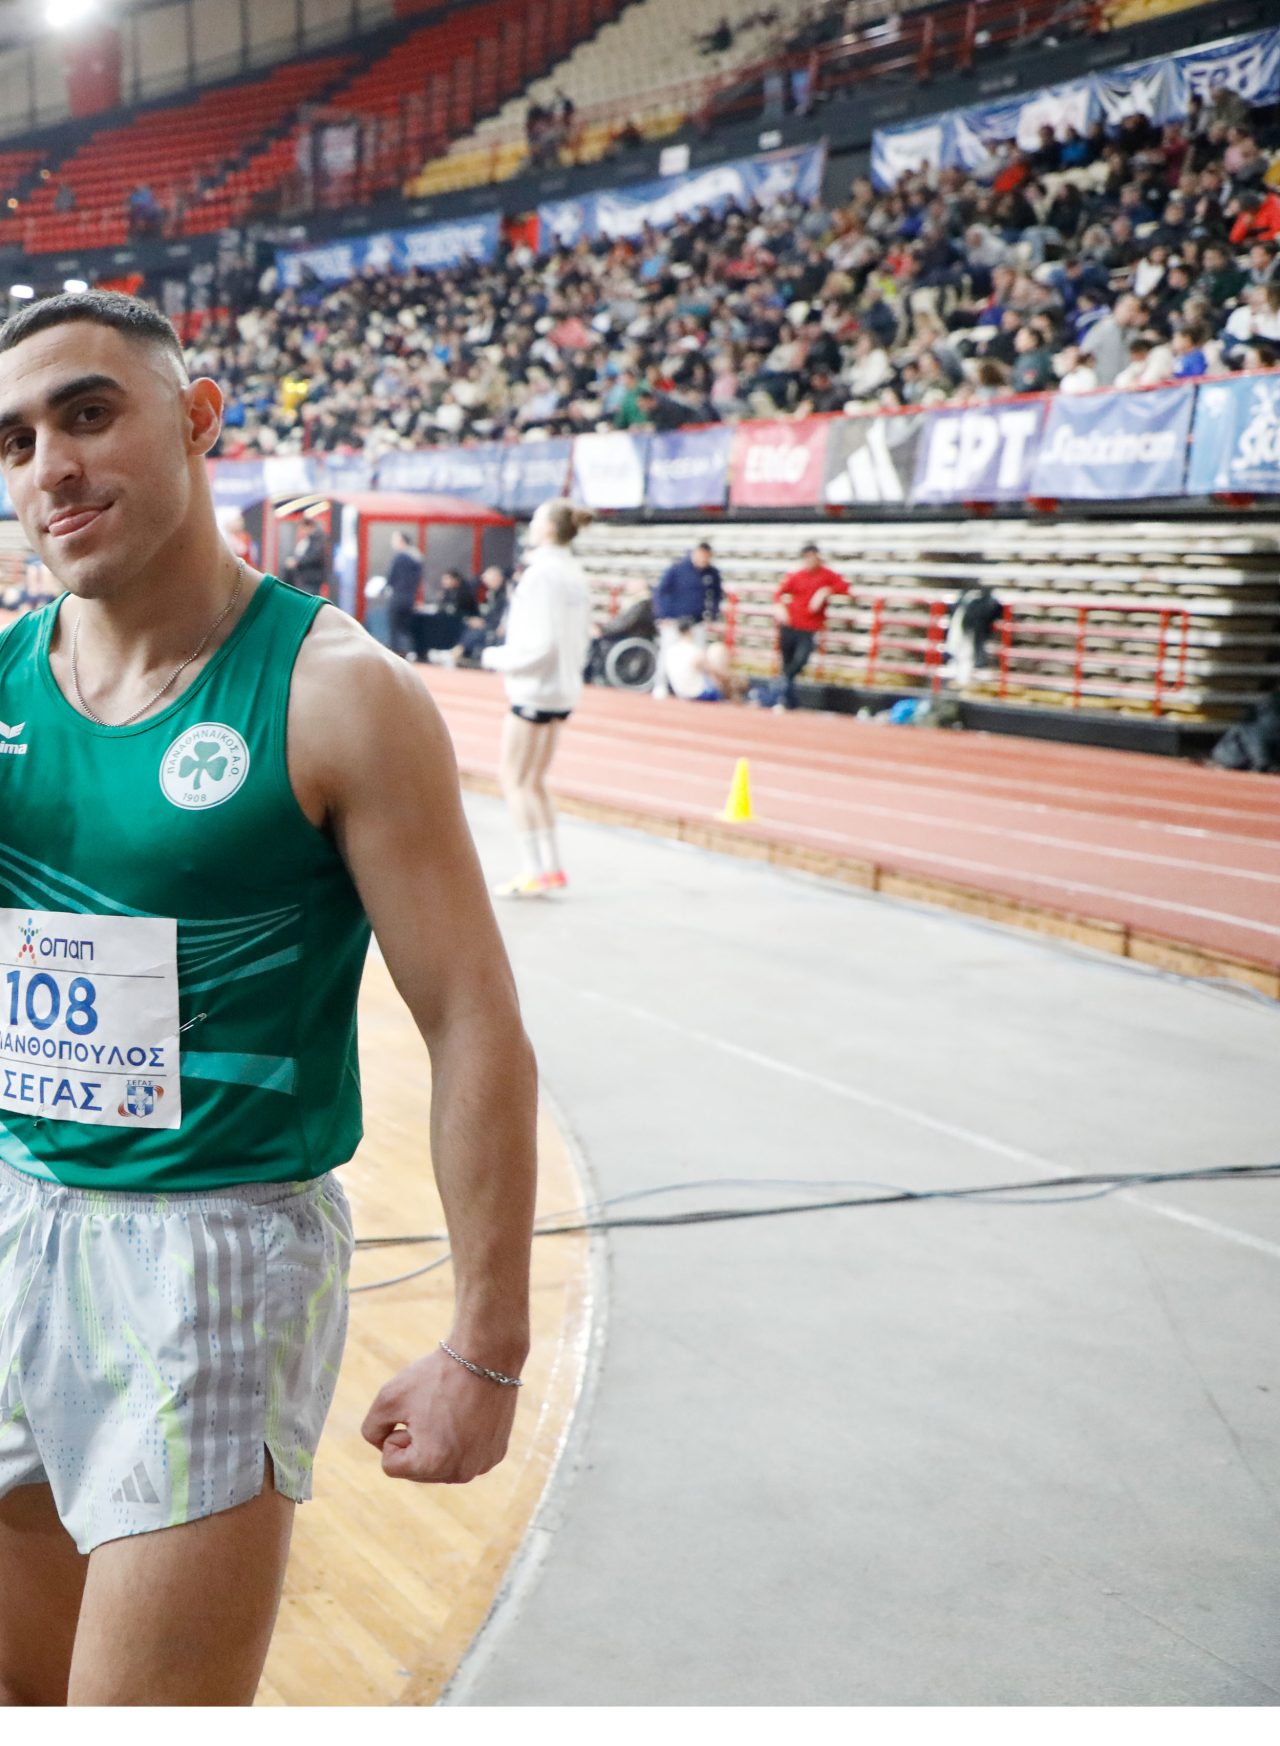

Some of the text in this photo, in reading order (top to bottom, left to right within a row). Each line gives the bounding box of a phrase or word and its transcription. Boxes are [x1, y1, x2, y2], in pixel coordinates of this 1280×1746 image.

[183, 793, 207, 802] 1908
[6, 970, 98, 1036] 108
[3, 1069, 103, 1112] ΣΕΓΑΣ
